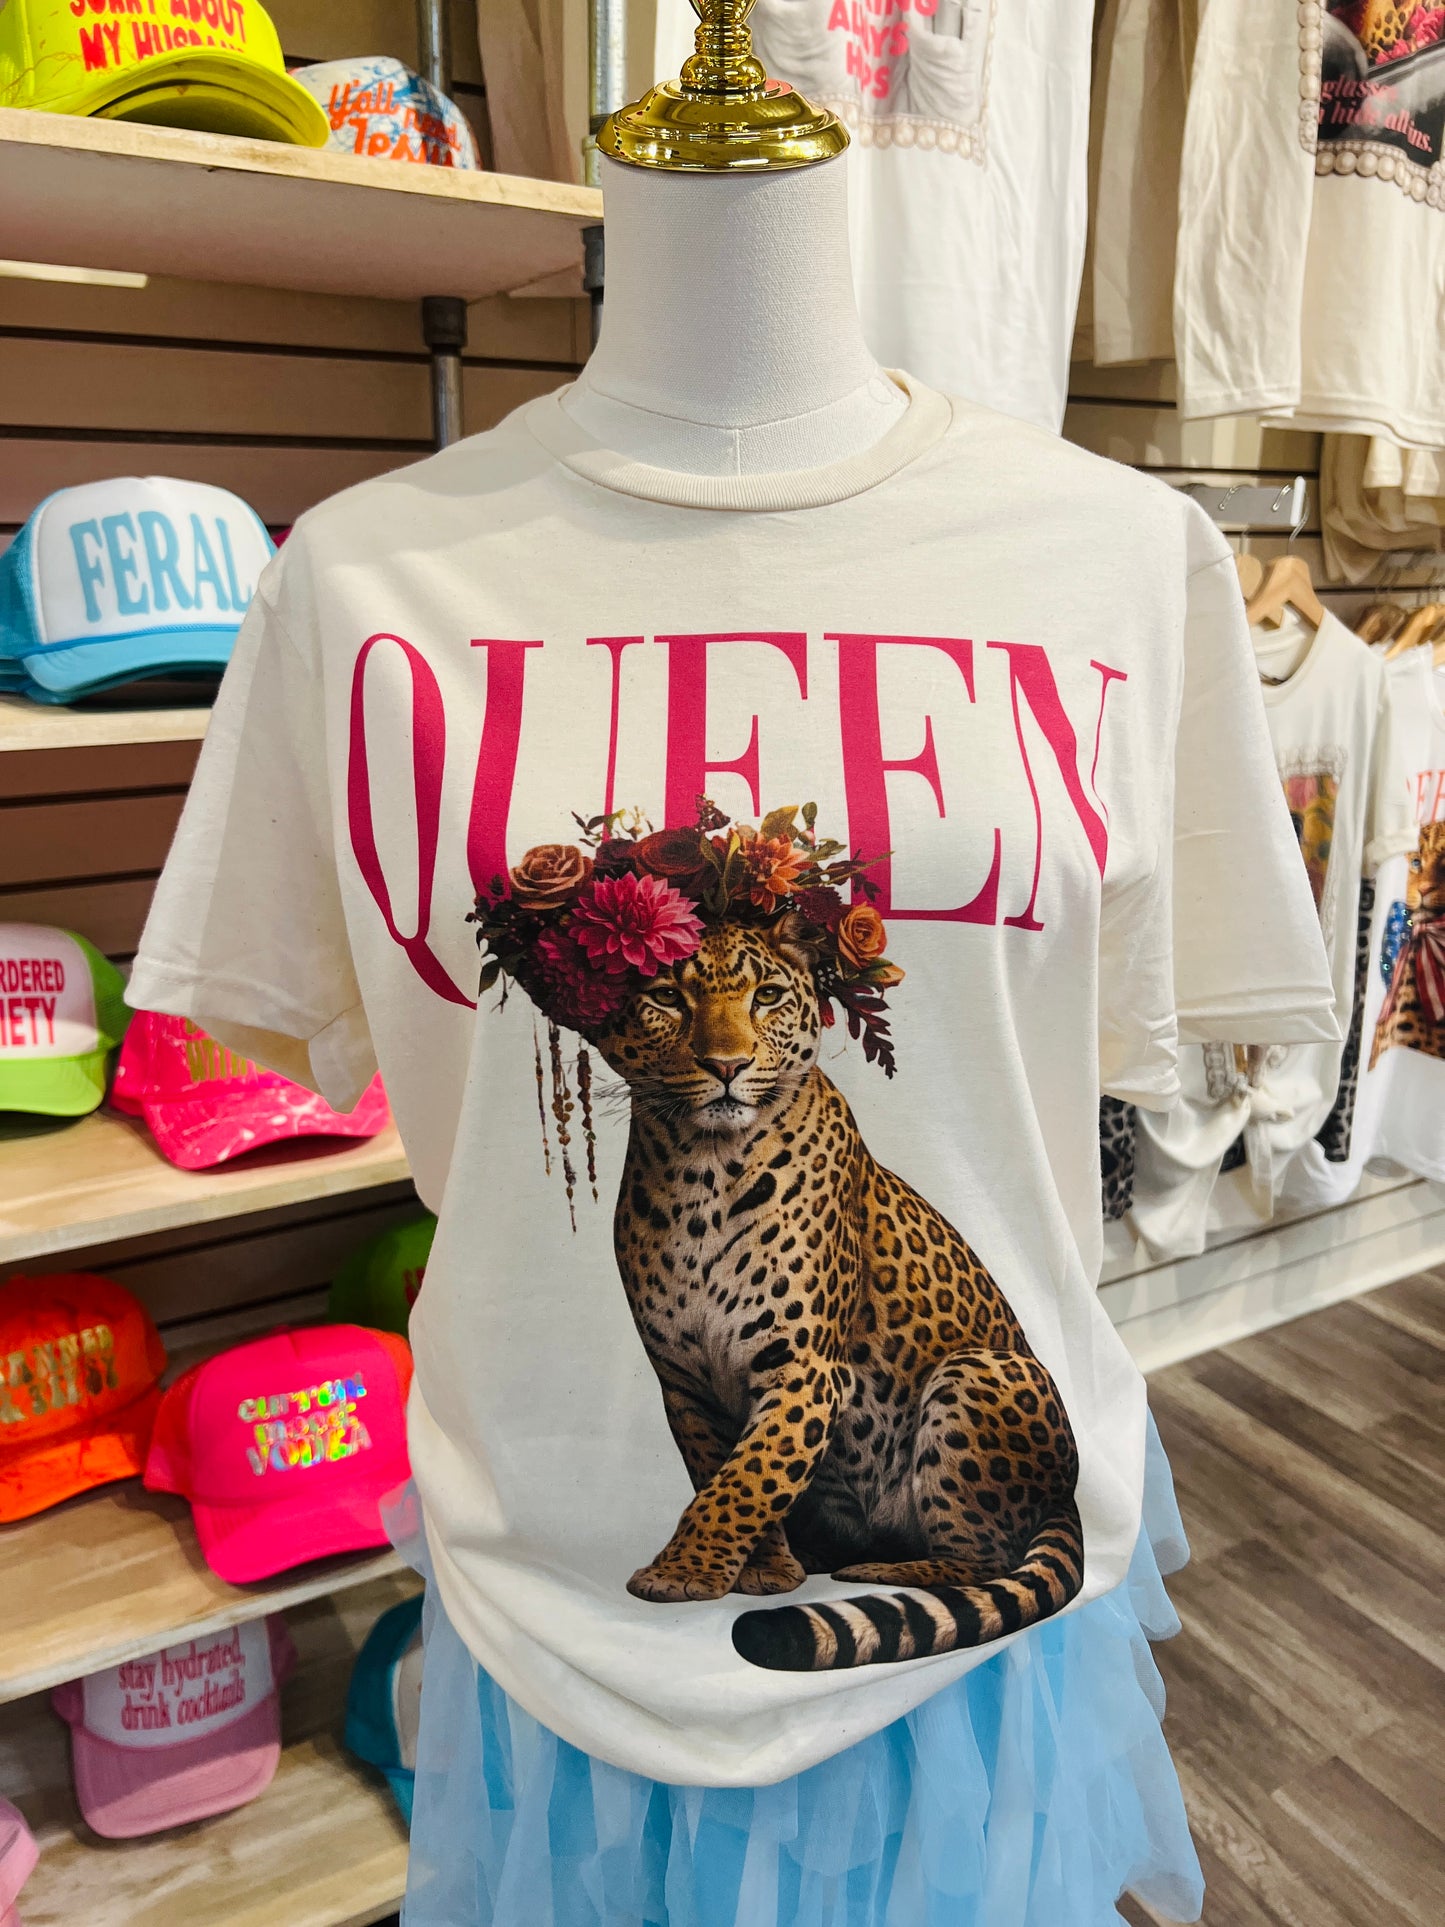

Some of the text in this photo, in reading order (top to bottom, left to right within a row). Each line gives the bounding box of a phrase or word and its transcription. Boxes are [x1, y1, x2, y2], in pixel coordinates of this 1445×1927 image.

[79, 20, 121, 72] MY
[69, 510, 251, 622] FERAL
[347, 631, 1128, 1011] QUEEN
[0, 1325, 114, 1388] ANNED
[121, 1691, 171, 1730] drink
